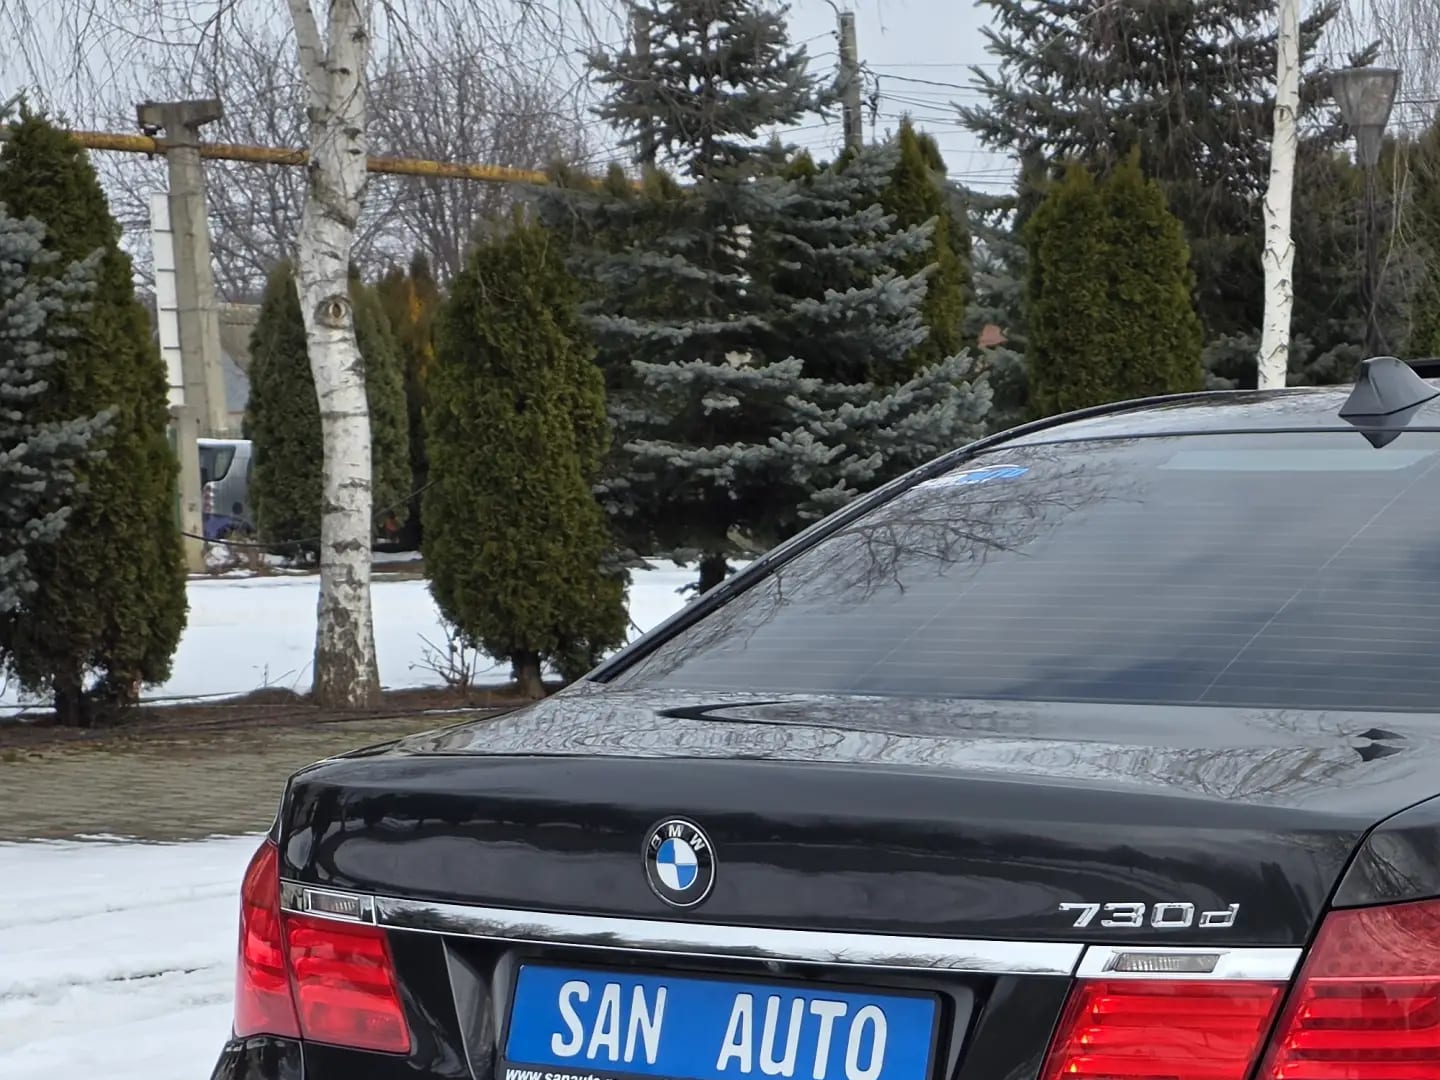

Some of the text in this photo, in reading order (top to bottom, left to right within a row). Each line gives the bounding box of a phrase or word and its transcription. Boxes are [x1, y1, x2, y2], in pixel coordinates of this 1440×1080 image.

[651, 824, 705, 851] BMW
[1058, 902, 1240, 928] 730d
[550, 980, 668, 1065] SAN
